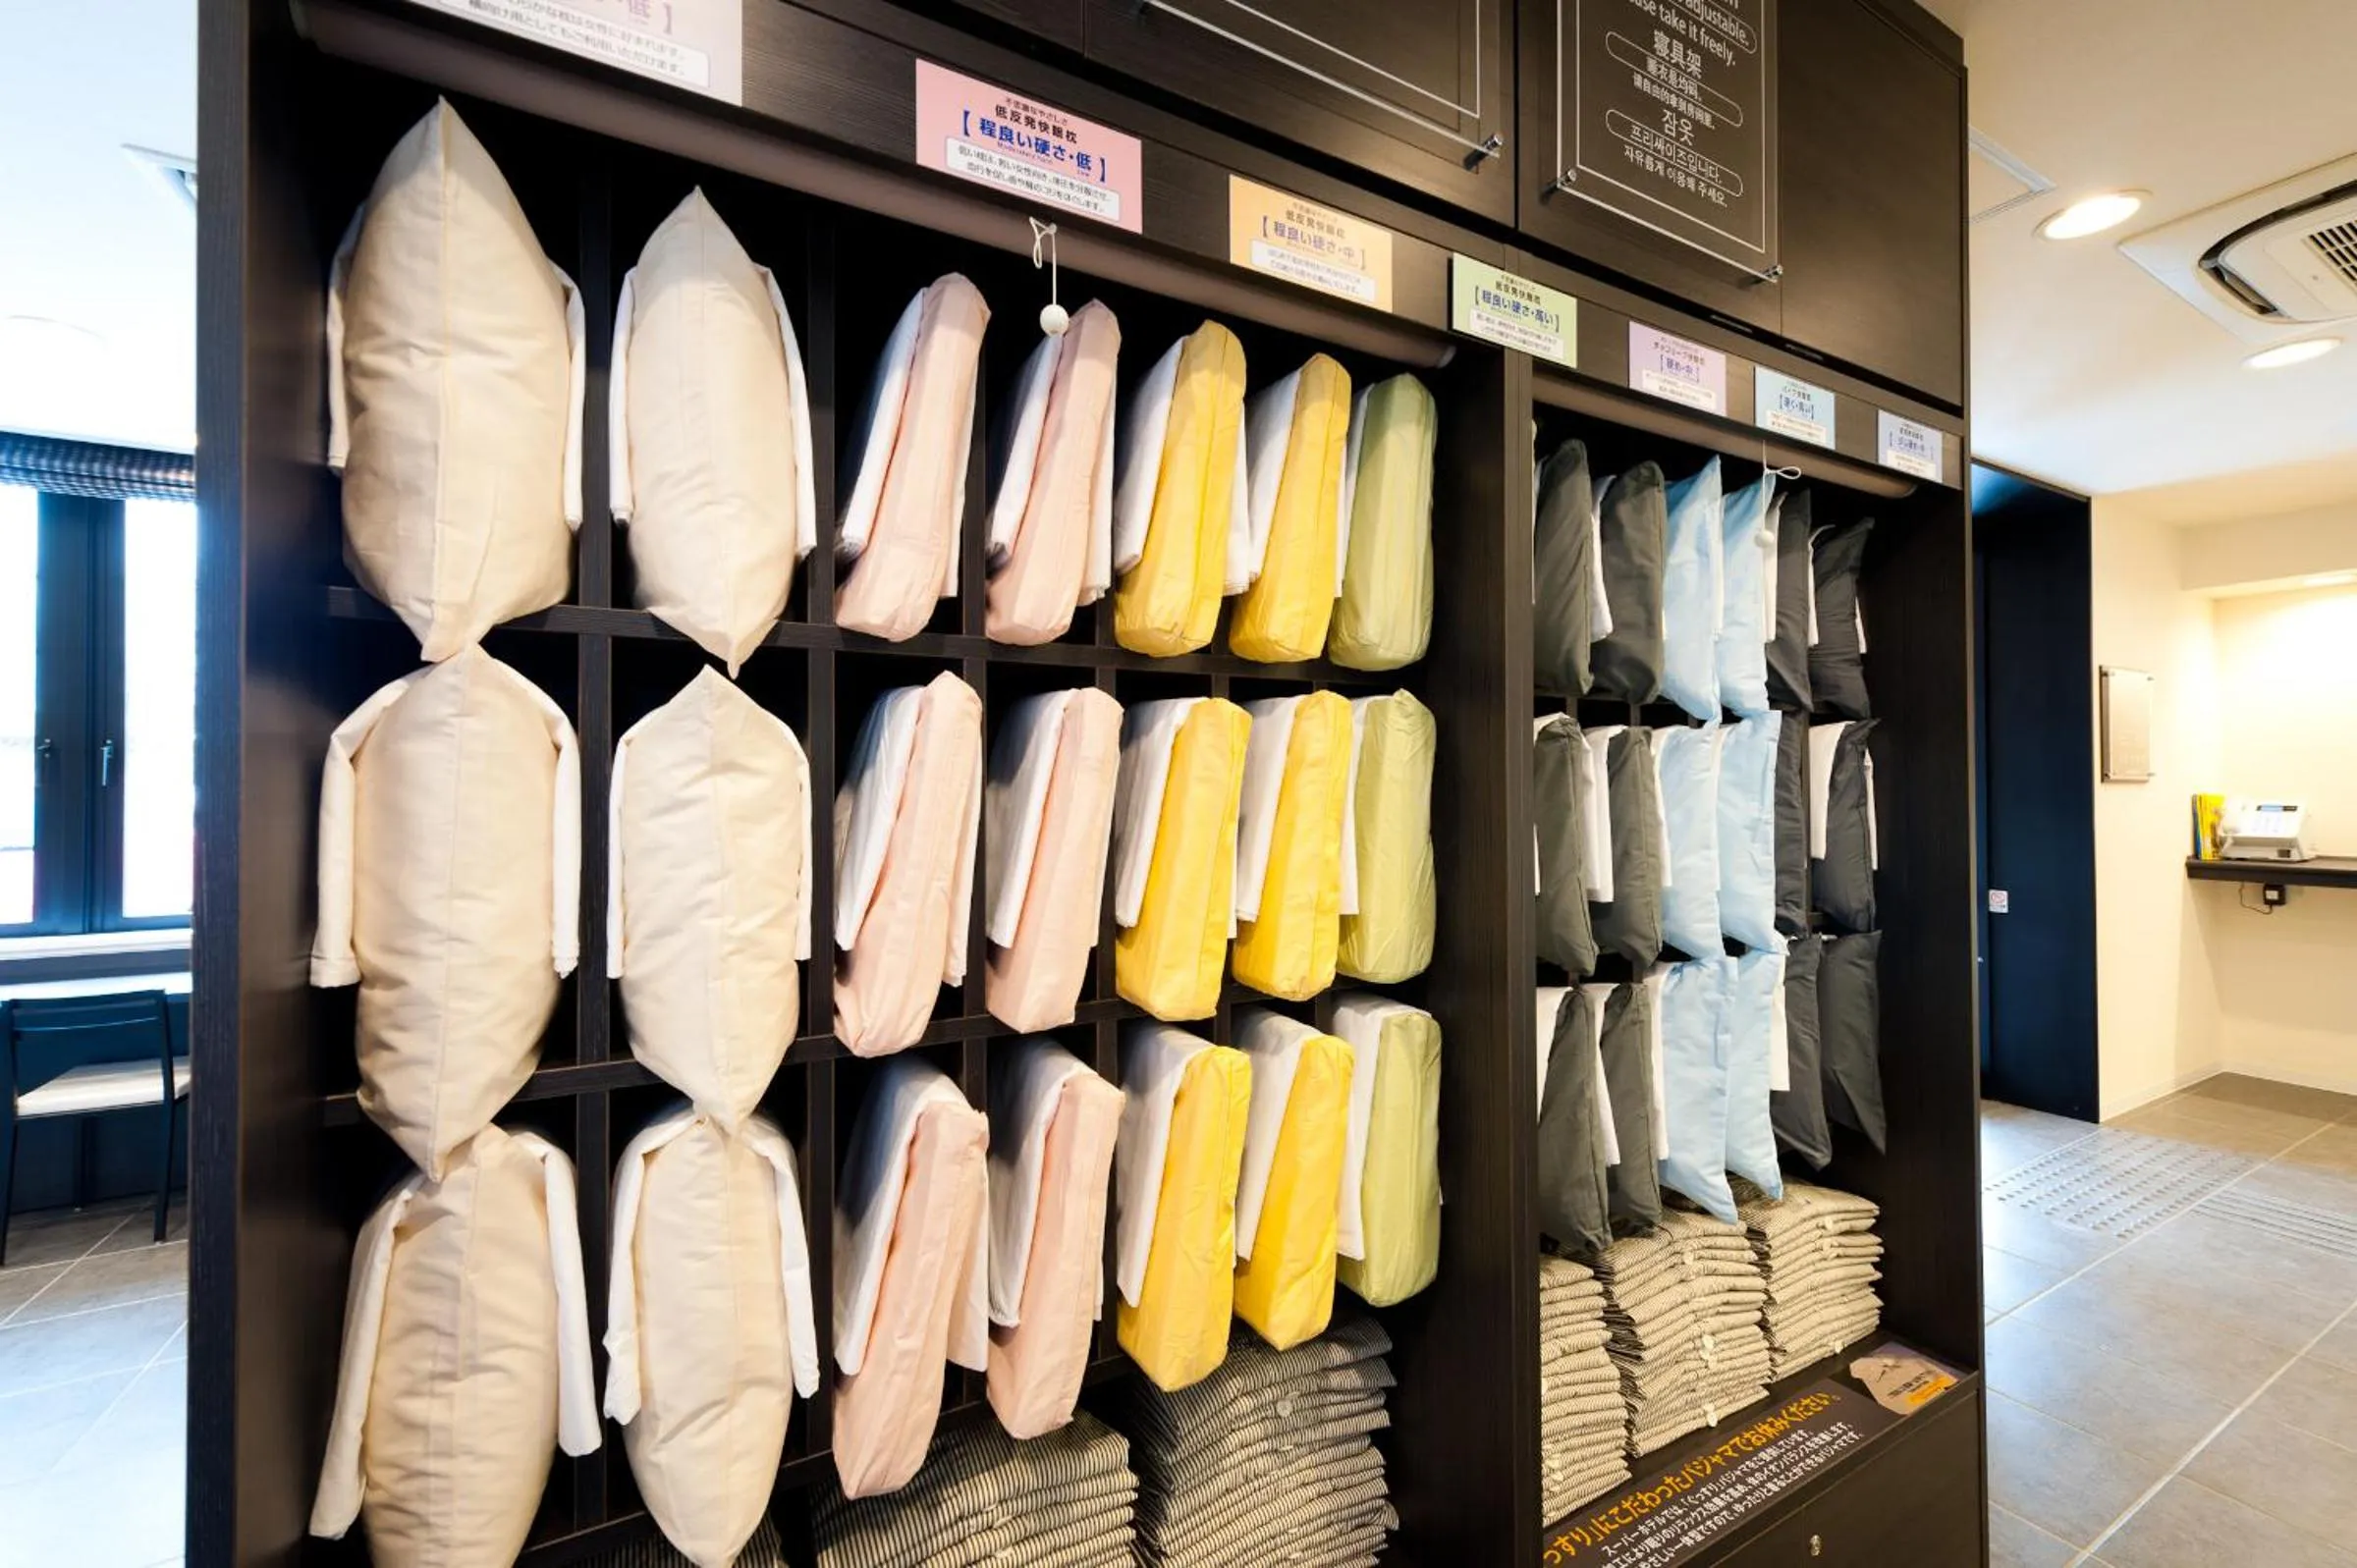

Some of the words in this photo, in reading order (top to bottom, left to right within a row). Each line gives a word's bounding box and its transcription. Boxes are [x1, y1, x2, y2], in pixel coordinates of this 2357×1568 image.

[1659, 4, 1686, 35] take
[1688, 21, 1698, 42] it
[1700, 27, 1736, 67] freely.
[995, 104, 1077, 144] 低反発快眠枕
[1661, 109, 1695, 147] 잠옷
